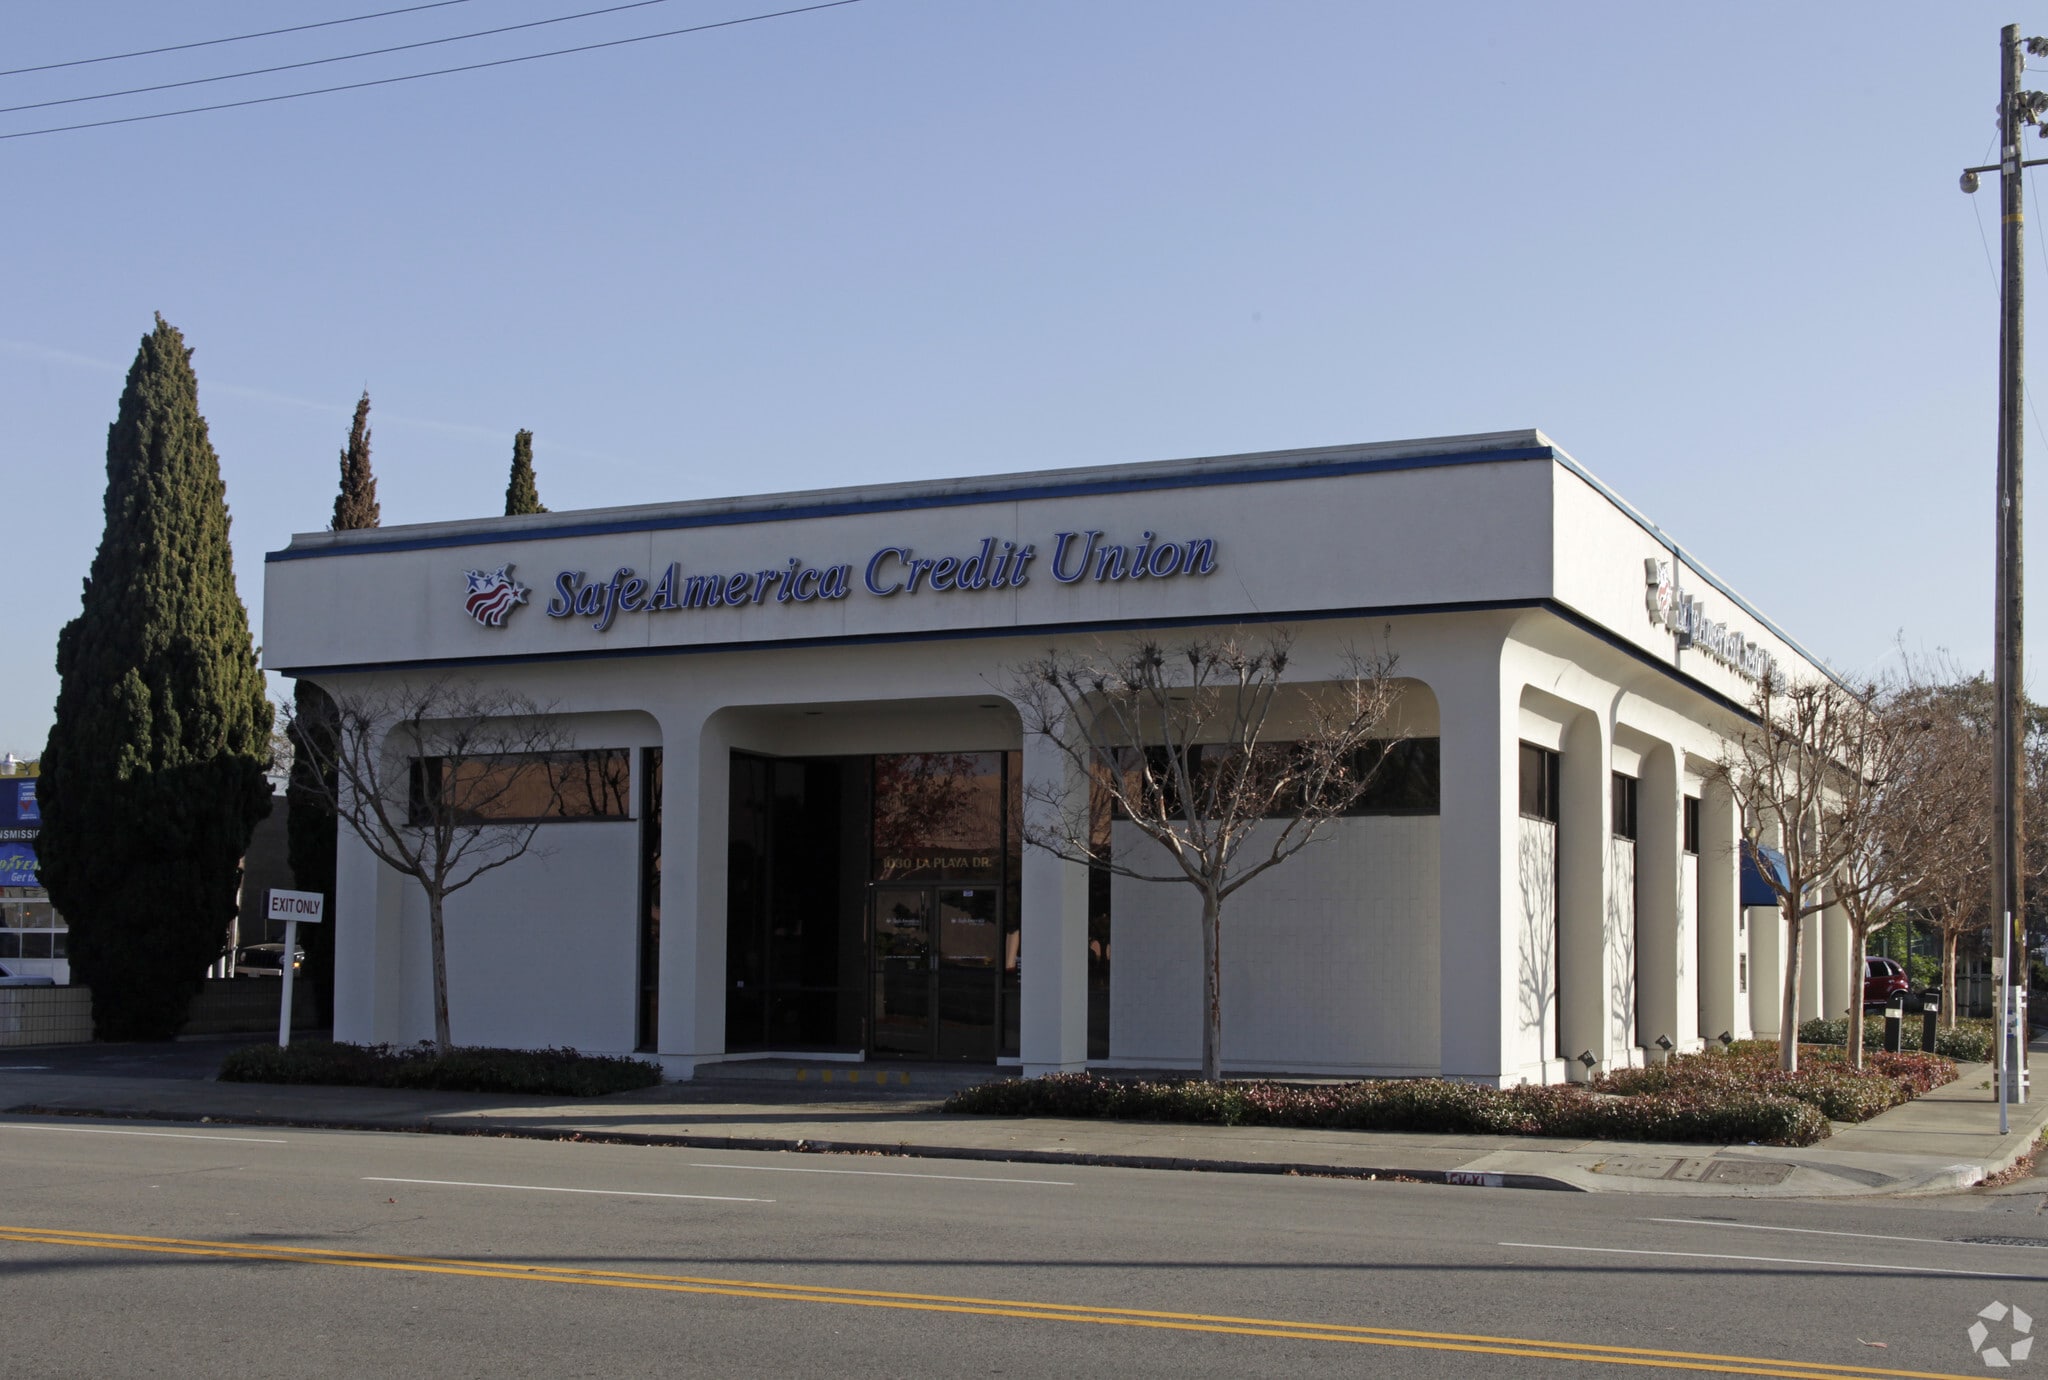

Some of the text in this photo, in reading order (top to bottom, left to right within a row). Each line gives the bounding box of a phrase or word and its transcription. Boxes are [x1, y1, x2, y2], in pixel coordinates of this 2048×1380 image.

[546, 530, 1219, 632] SafeAmerica Credit Union
[933, 857, 969, 868] PLAYA
[272, 897, 320, 914] EXIT ONLY
